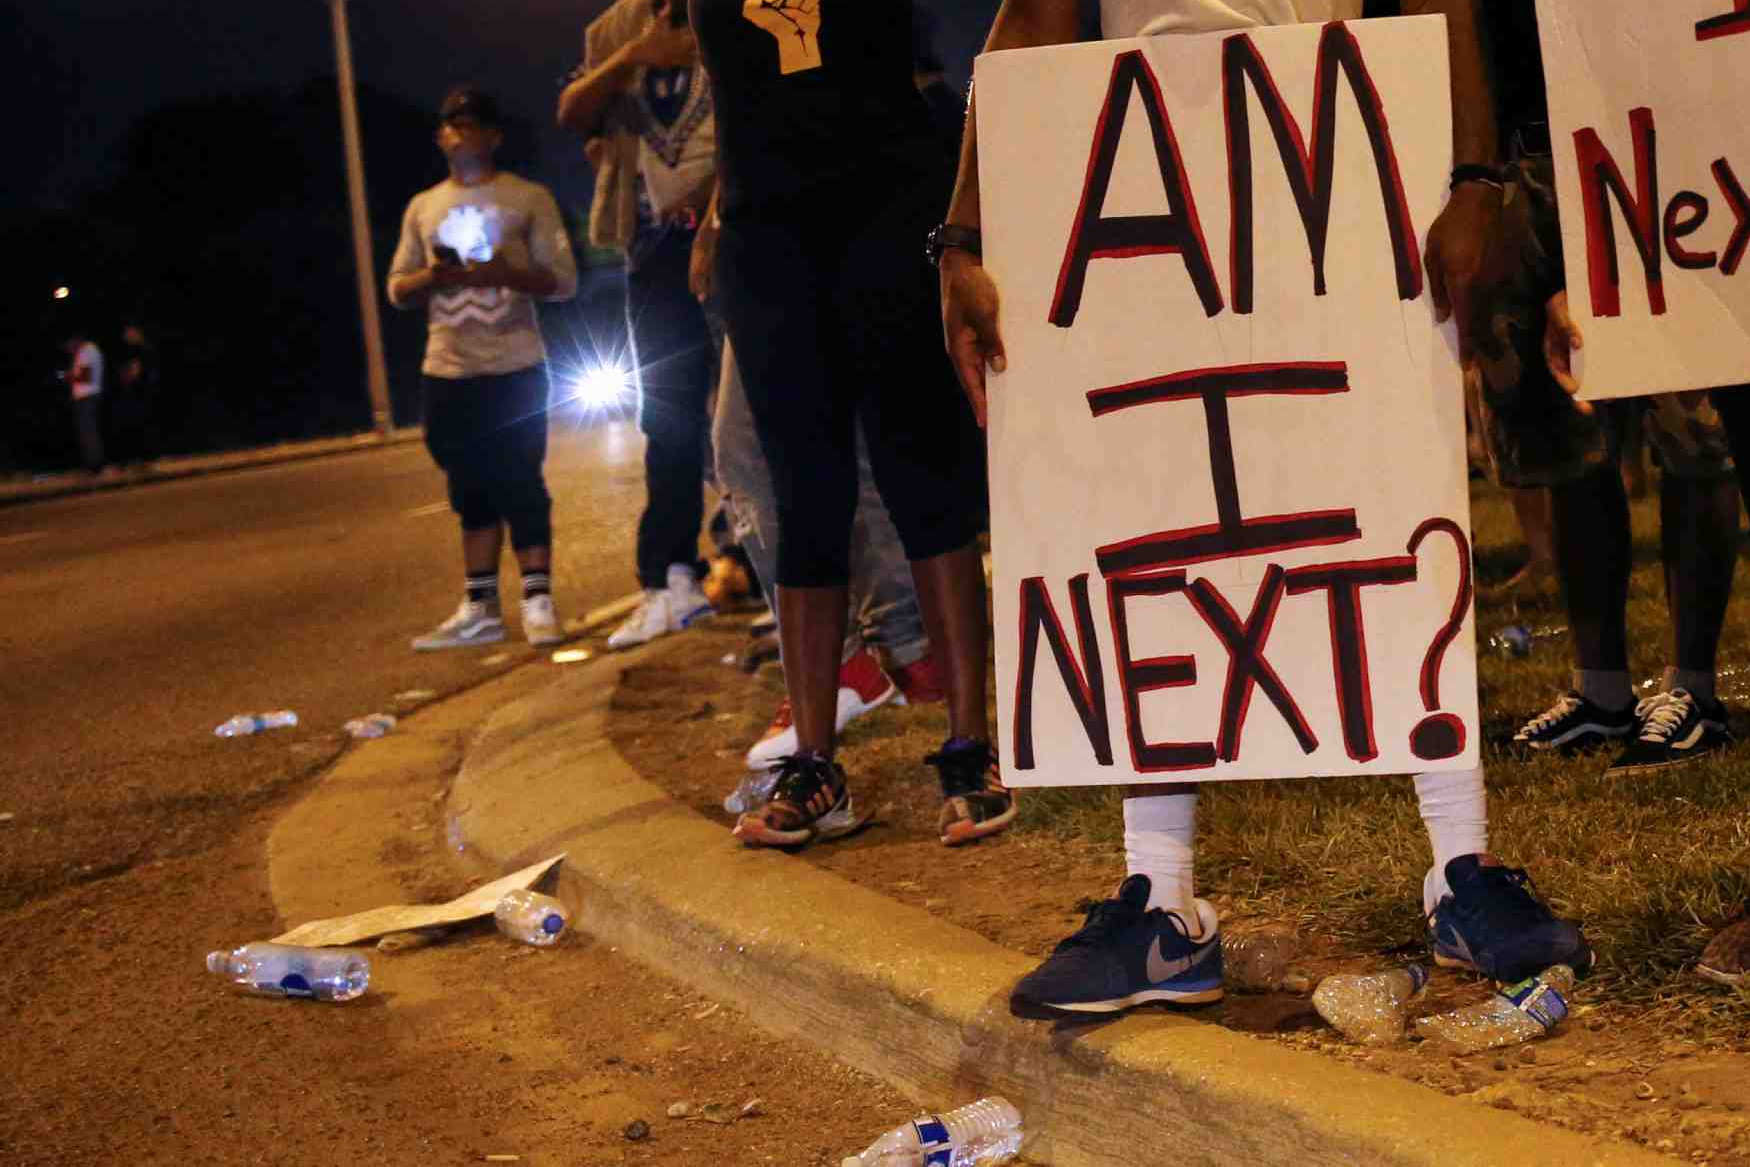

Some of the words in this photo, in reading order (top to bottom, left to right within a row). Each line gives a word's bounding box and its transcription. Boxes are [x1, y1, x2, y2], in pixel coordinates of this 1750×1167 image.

[1047, 20, 1424, 327] AM
[1085, 361, 1362, 579] I
[1013, 517, 1473, 773] NEXT?
